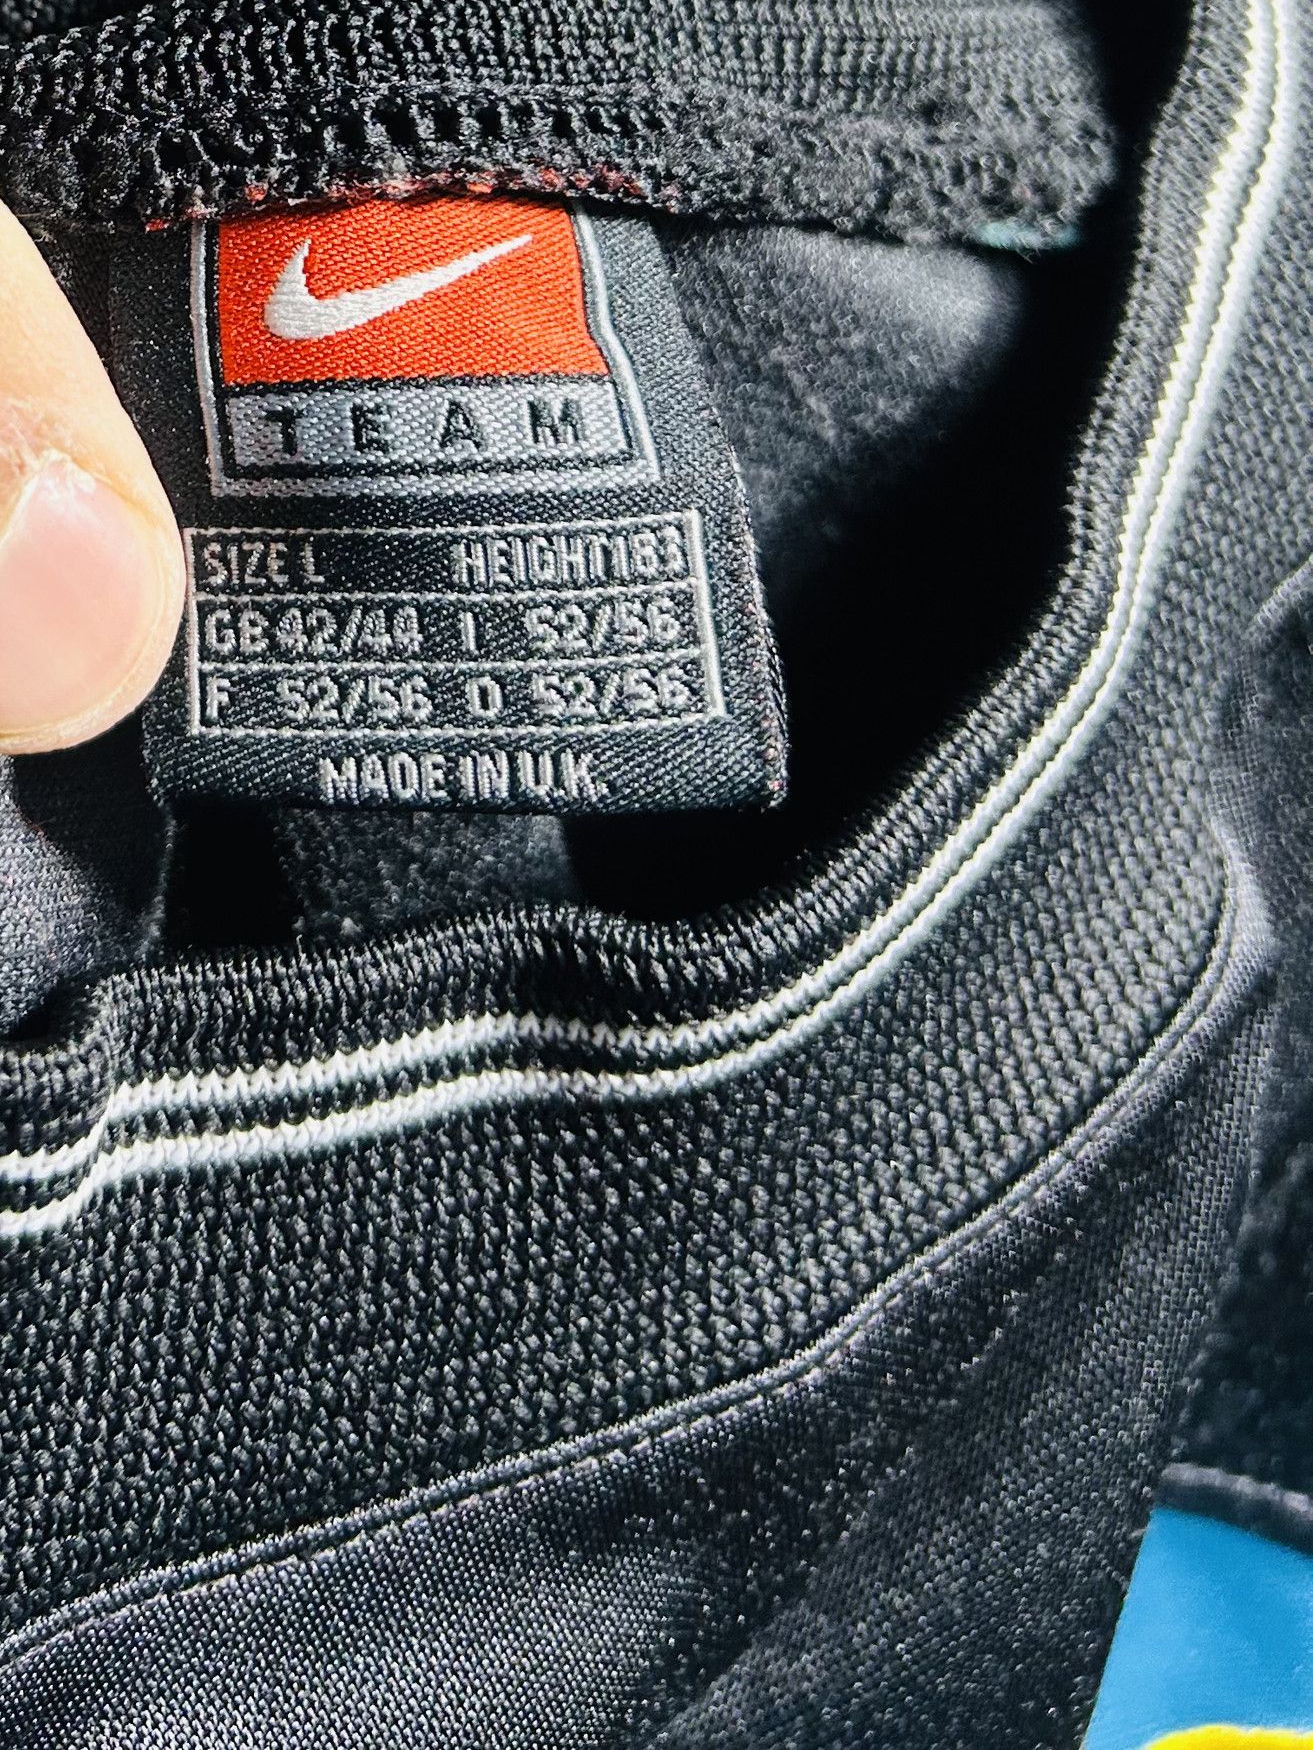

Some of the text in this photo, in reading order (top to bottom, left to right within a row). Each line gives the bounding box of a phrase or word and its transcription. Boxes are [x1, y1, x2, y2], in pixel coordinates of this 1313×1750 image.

[264, 396, 583, 456] TEAM
[202, 541, 289, 586] SIZE
[300, 541, 327, 585] L
[525, 599, 682, 652] 52/56
[205, 677, 233, 722] F
[277, 674, 435, 724] 52/56
[532, 665, 691, 719] 52/56
[318, 751, 450, 804] MADE
[456, 749, 511, 801] IN
